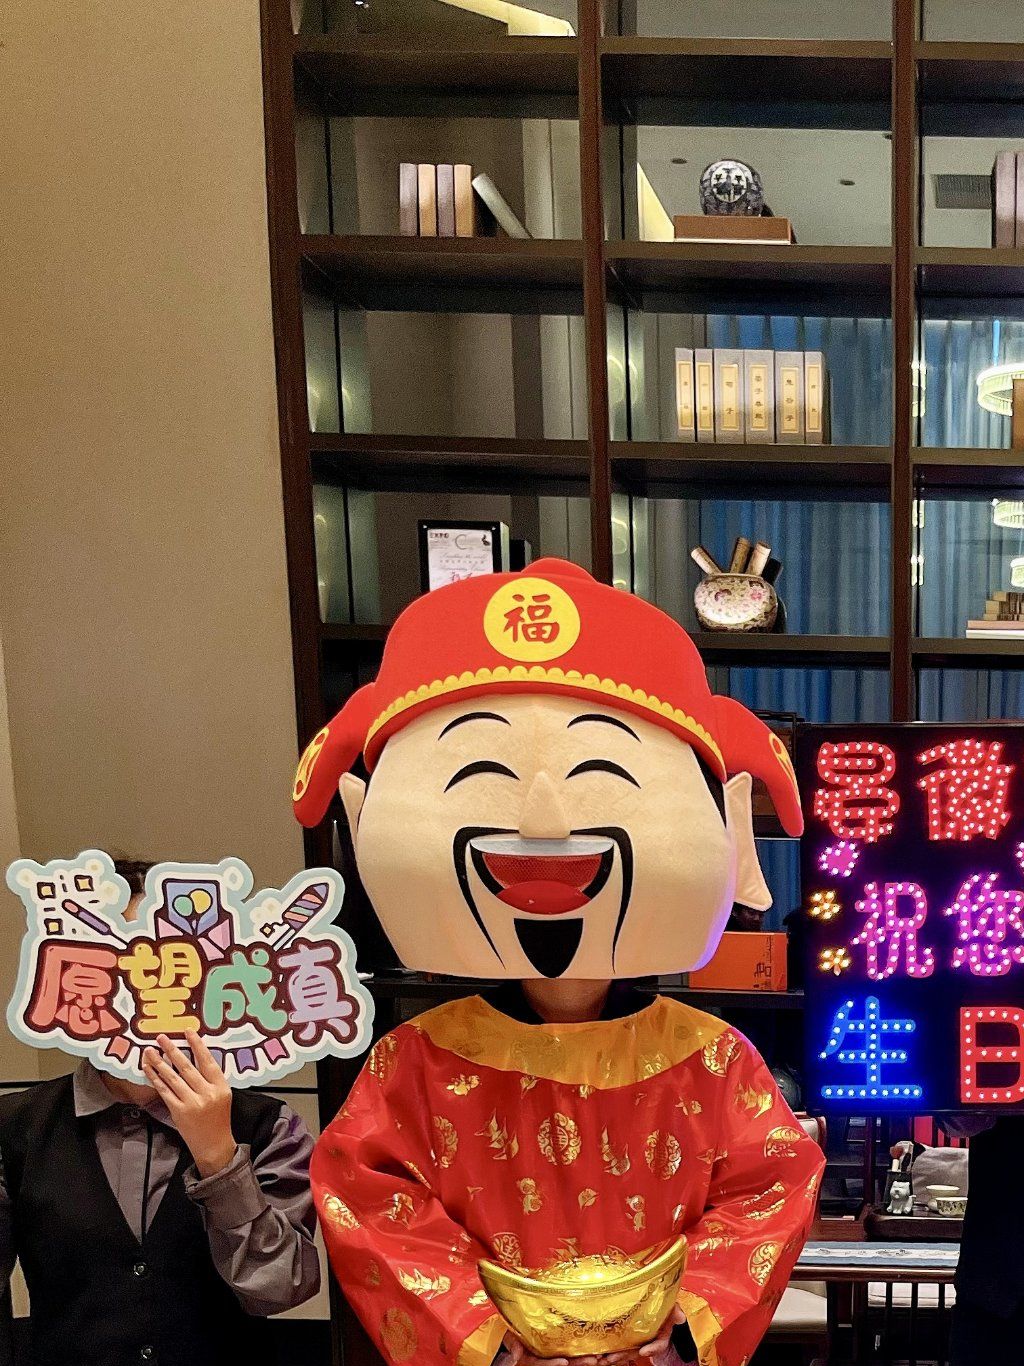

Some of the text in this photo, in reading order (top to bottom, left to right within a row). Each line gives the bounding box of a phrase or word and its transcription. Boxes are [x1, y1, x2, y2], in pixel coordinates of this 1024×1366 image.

[503, 594, 560, 643] 福
[30, 942, 352, 1040] 愿望成真
